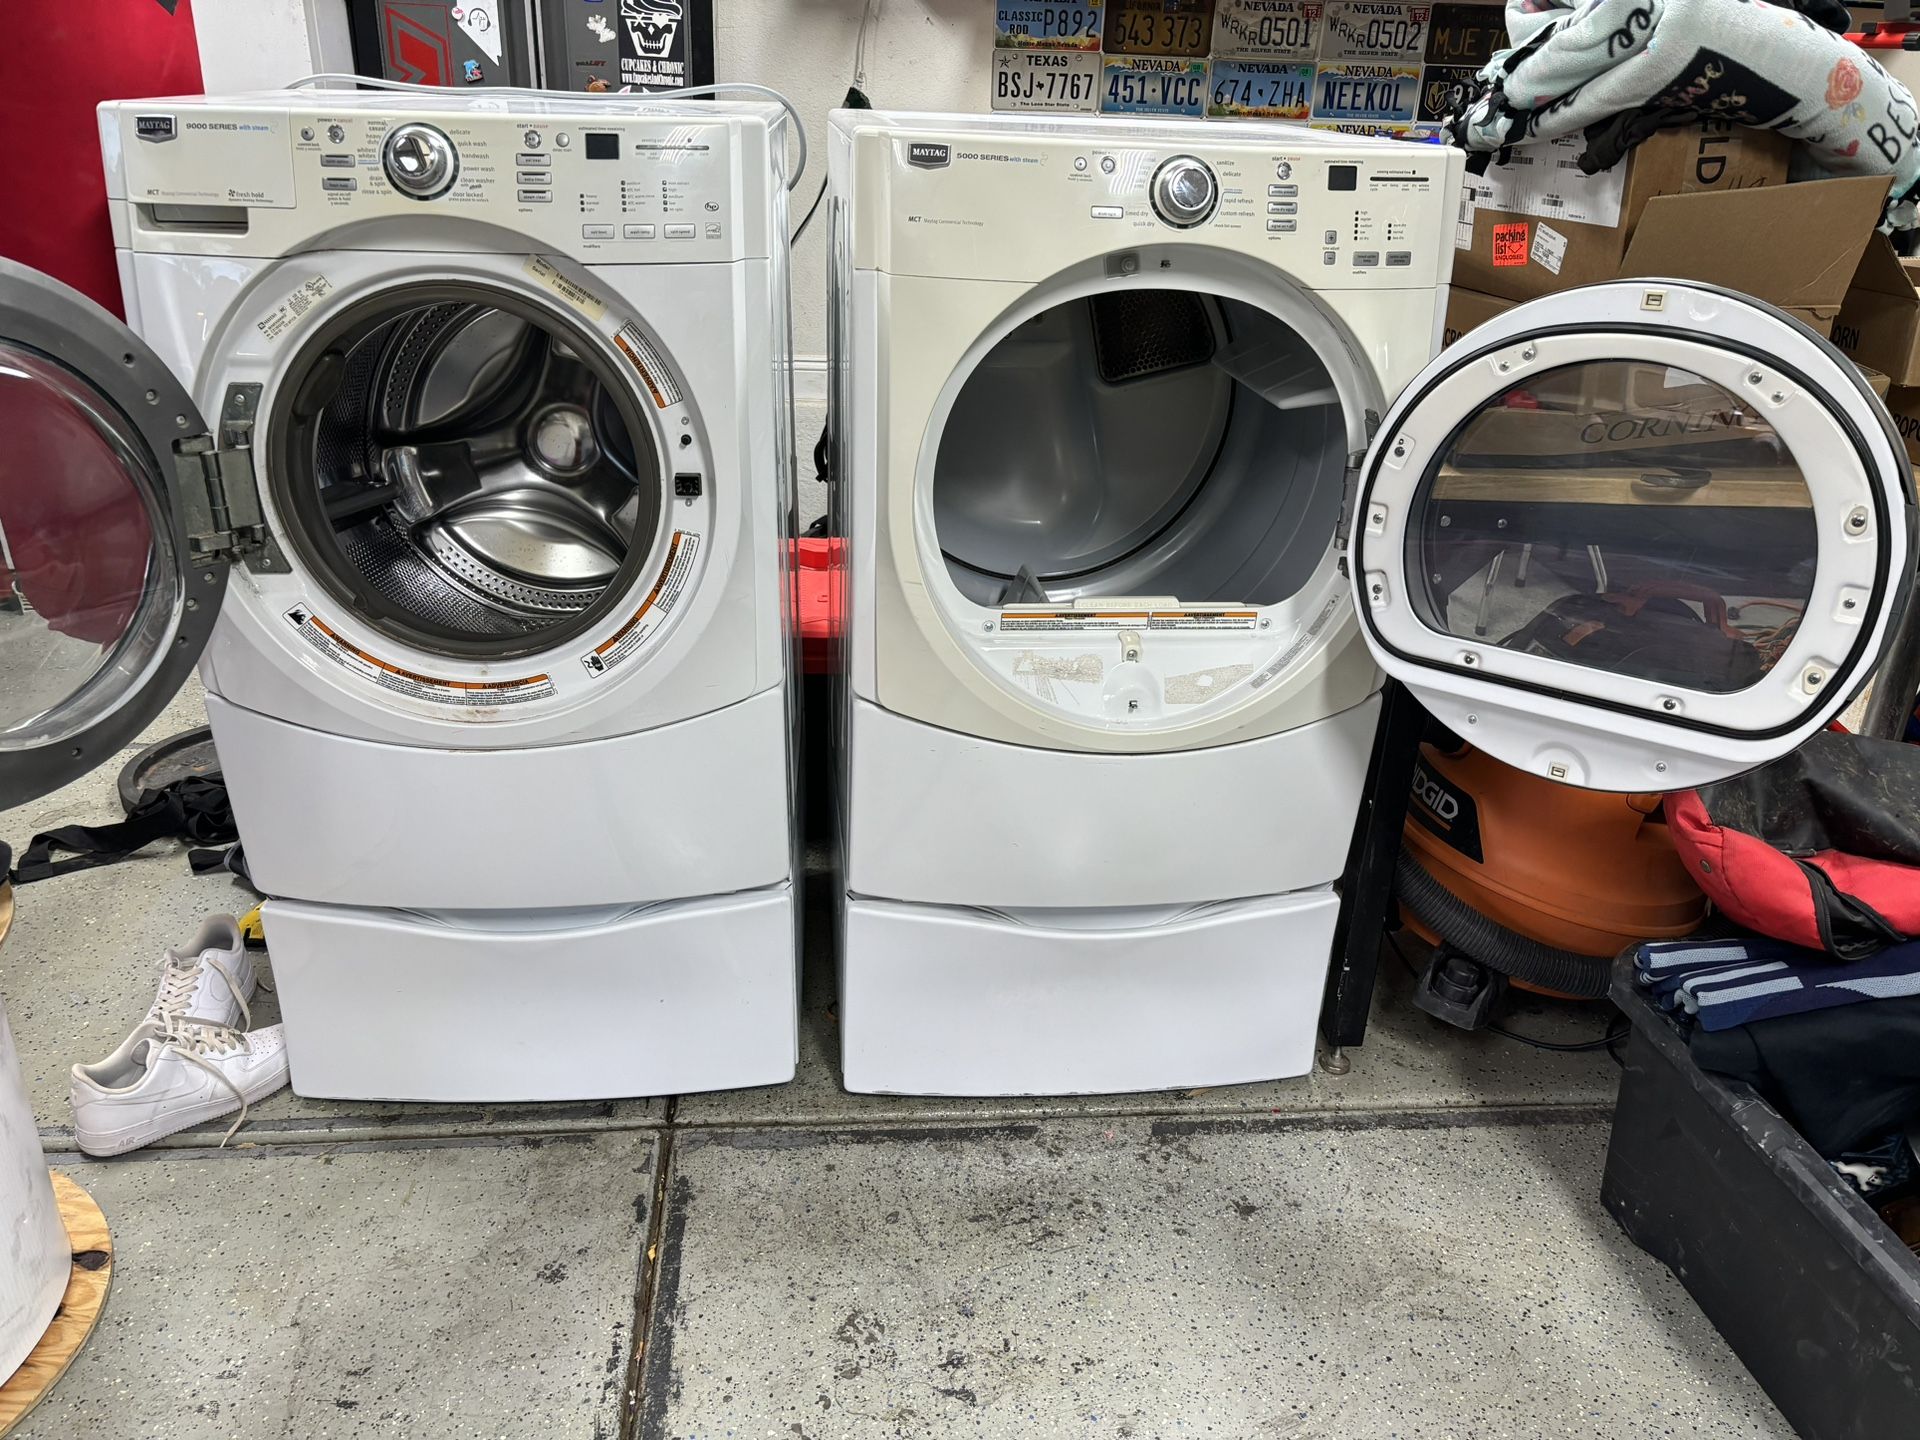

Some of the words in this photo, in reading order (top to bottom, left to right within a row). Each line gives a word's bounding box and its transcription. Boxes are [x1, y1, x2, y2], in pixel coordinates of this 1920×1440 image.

[1243, 1, 1294, 13] NEVADA
[1352, 4, 1402, 15] NEVADA
[998, 10, 1043, 22] CLASSIC
[1043, 9, 1097, 38] P892
[1009, 24, 1029, 35] ROD
[1113, 14, 1155, 46] 543
[1161, 16, 1202, 48] 373
[1221, 13, 1258, 46] WRKR
[1258, 16, 1310, 48] 0501
[1329, 15, 1366, 48] WRKR
[1366, 19, 1422, 51] 0502
[1432, 27, 1480, 56] MJE
[620, 58, 651, 73] CUPCAKES
[652, 60, 657, 73] &
[657, 60, 684, 75] CHRONIC
[1026, 55, 1068, 67] TEXAS
[1131, 59, 1181, 72] NEVADA
[1237, 63, 1288, 74] NEVADA
[1344, 65, 1393, 78] NEVADA
[1322, 81, 1403, 112] NEEKOL
[138, 120, 170, 130] MAYTAG
[186, 122, 208, 130] 9000
[912, 148, 946, 157] MAYTAG
[956, 152, 979, 160] 5000
[1495, 229, 1526, 243] packing
[1495, 243, 1507, 255] list
[532, 265, 546, 277] Serial
[536, 258, 551, 271] Model
[334, 634, 361, 656] WARNING
[401, 671, 451, 687] AVERTISSEMENT
[487, 678, 530, 690] ADVERTENCIA
[1411, 762, 1459, 820] IDGID
[117, 1136, 136, 1149] AIR
